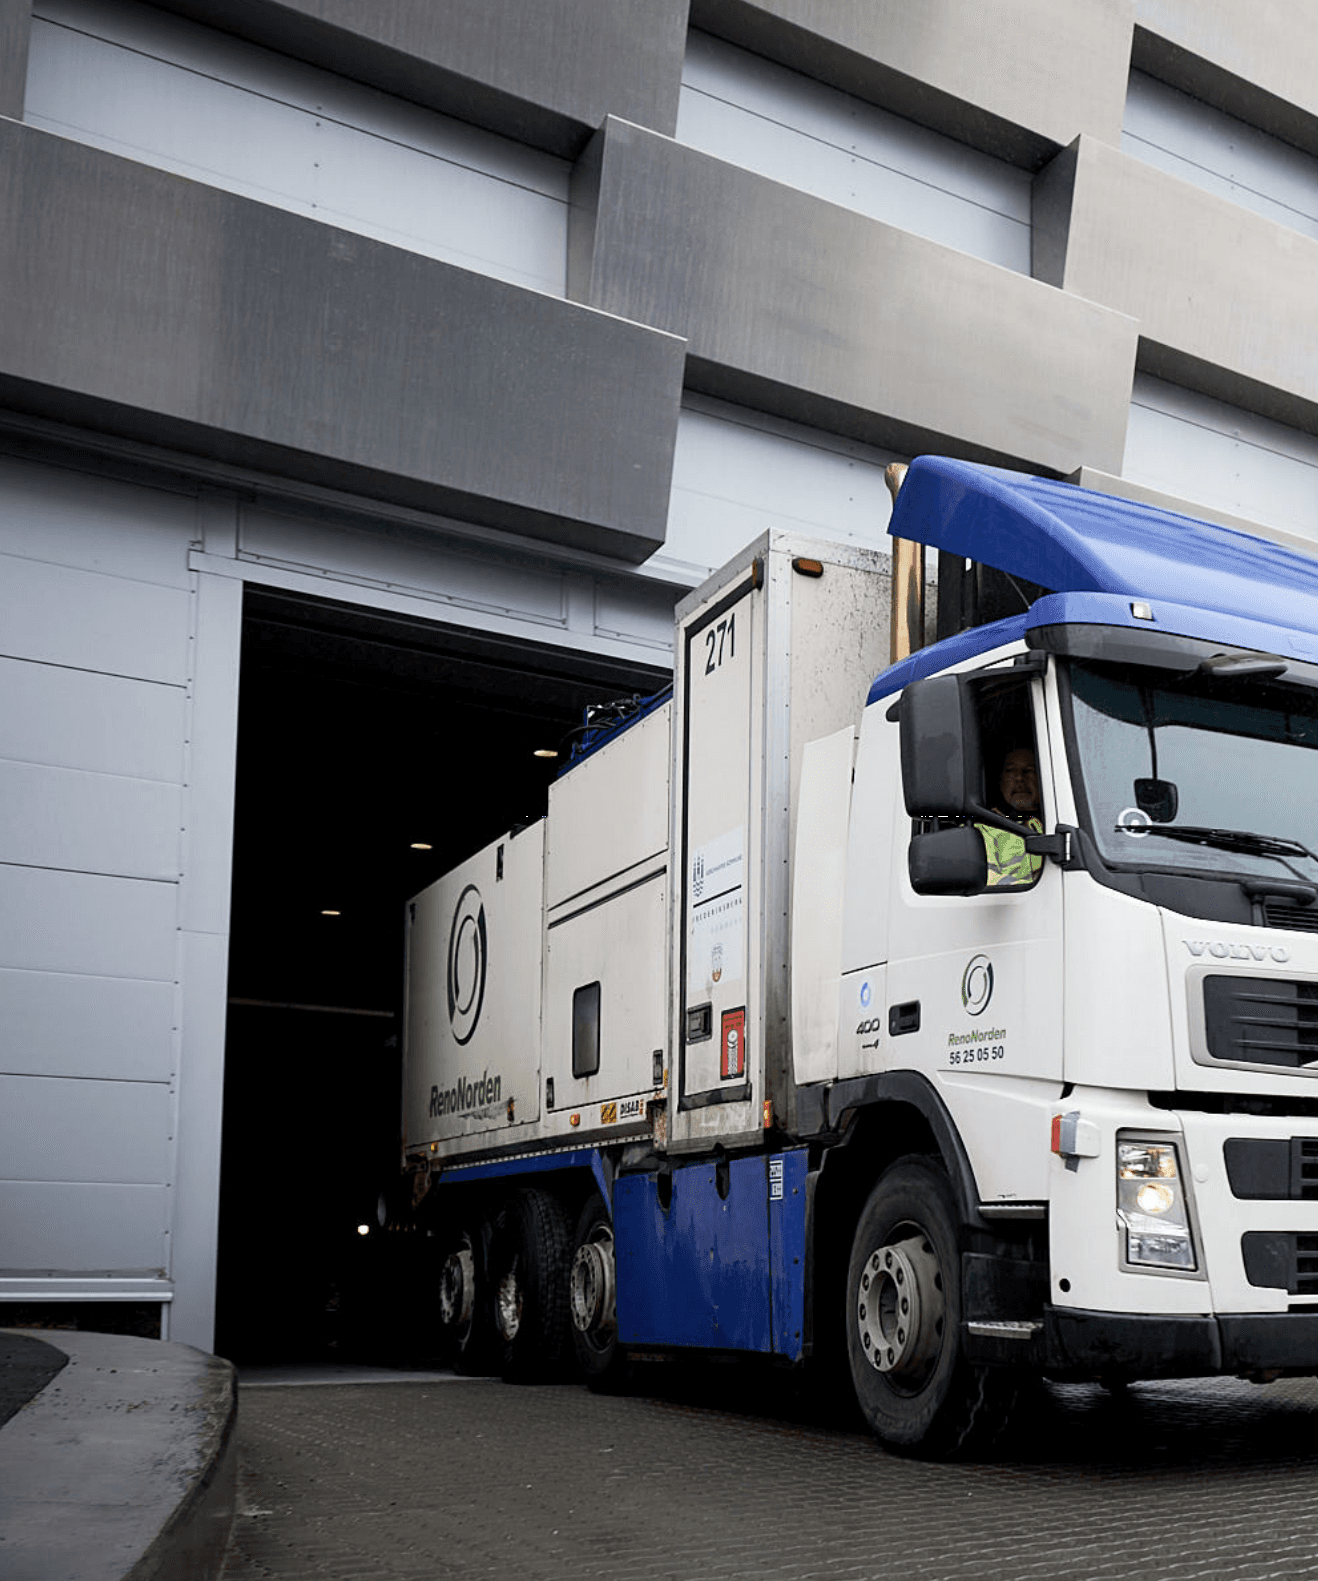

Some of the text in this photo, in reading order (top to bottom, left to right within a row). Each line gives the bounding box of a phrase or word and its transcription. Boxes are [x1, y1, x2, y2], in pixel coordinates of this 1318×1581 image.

[705, 612, 735, 676] 271
[1181, 940, 1290, 963] VOLVO
[948, 1027, 1007, 1047] RenoNorden
[949, 1045, 1004, 1065] 56 25 05 50
[429, 1066, 501, 1119] RenoNorden
